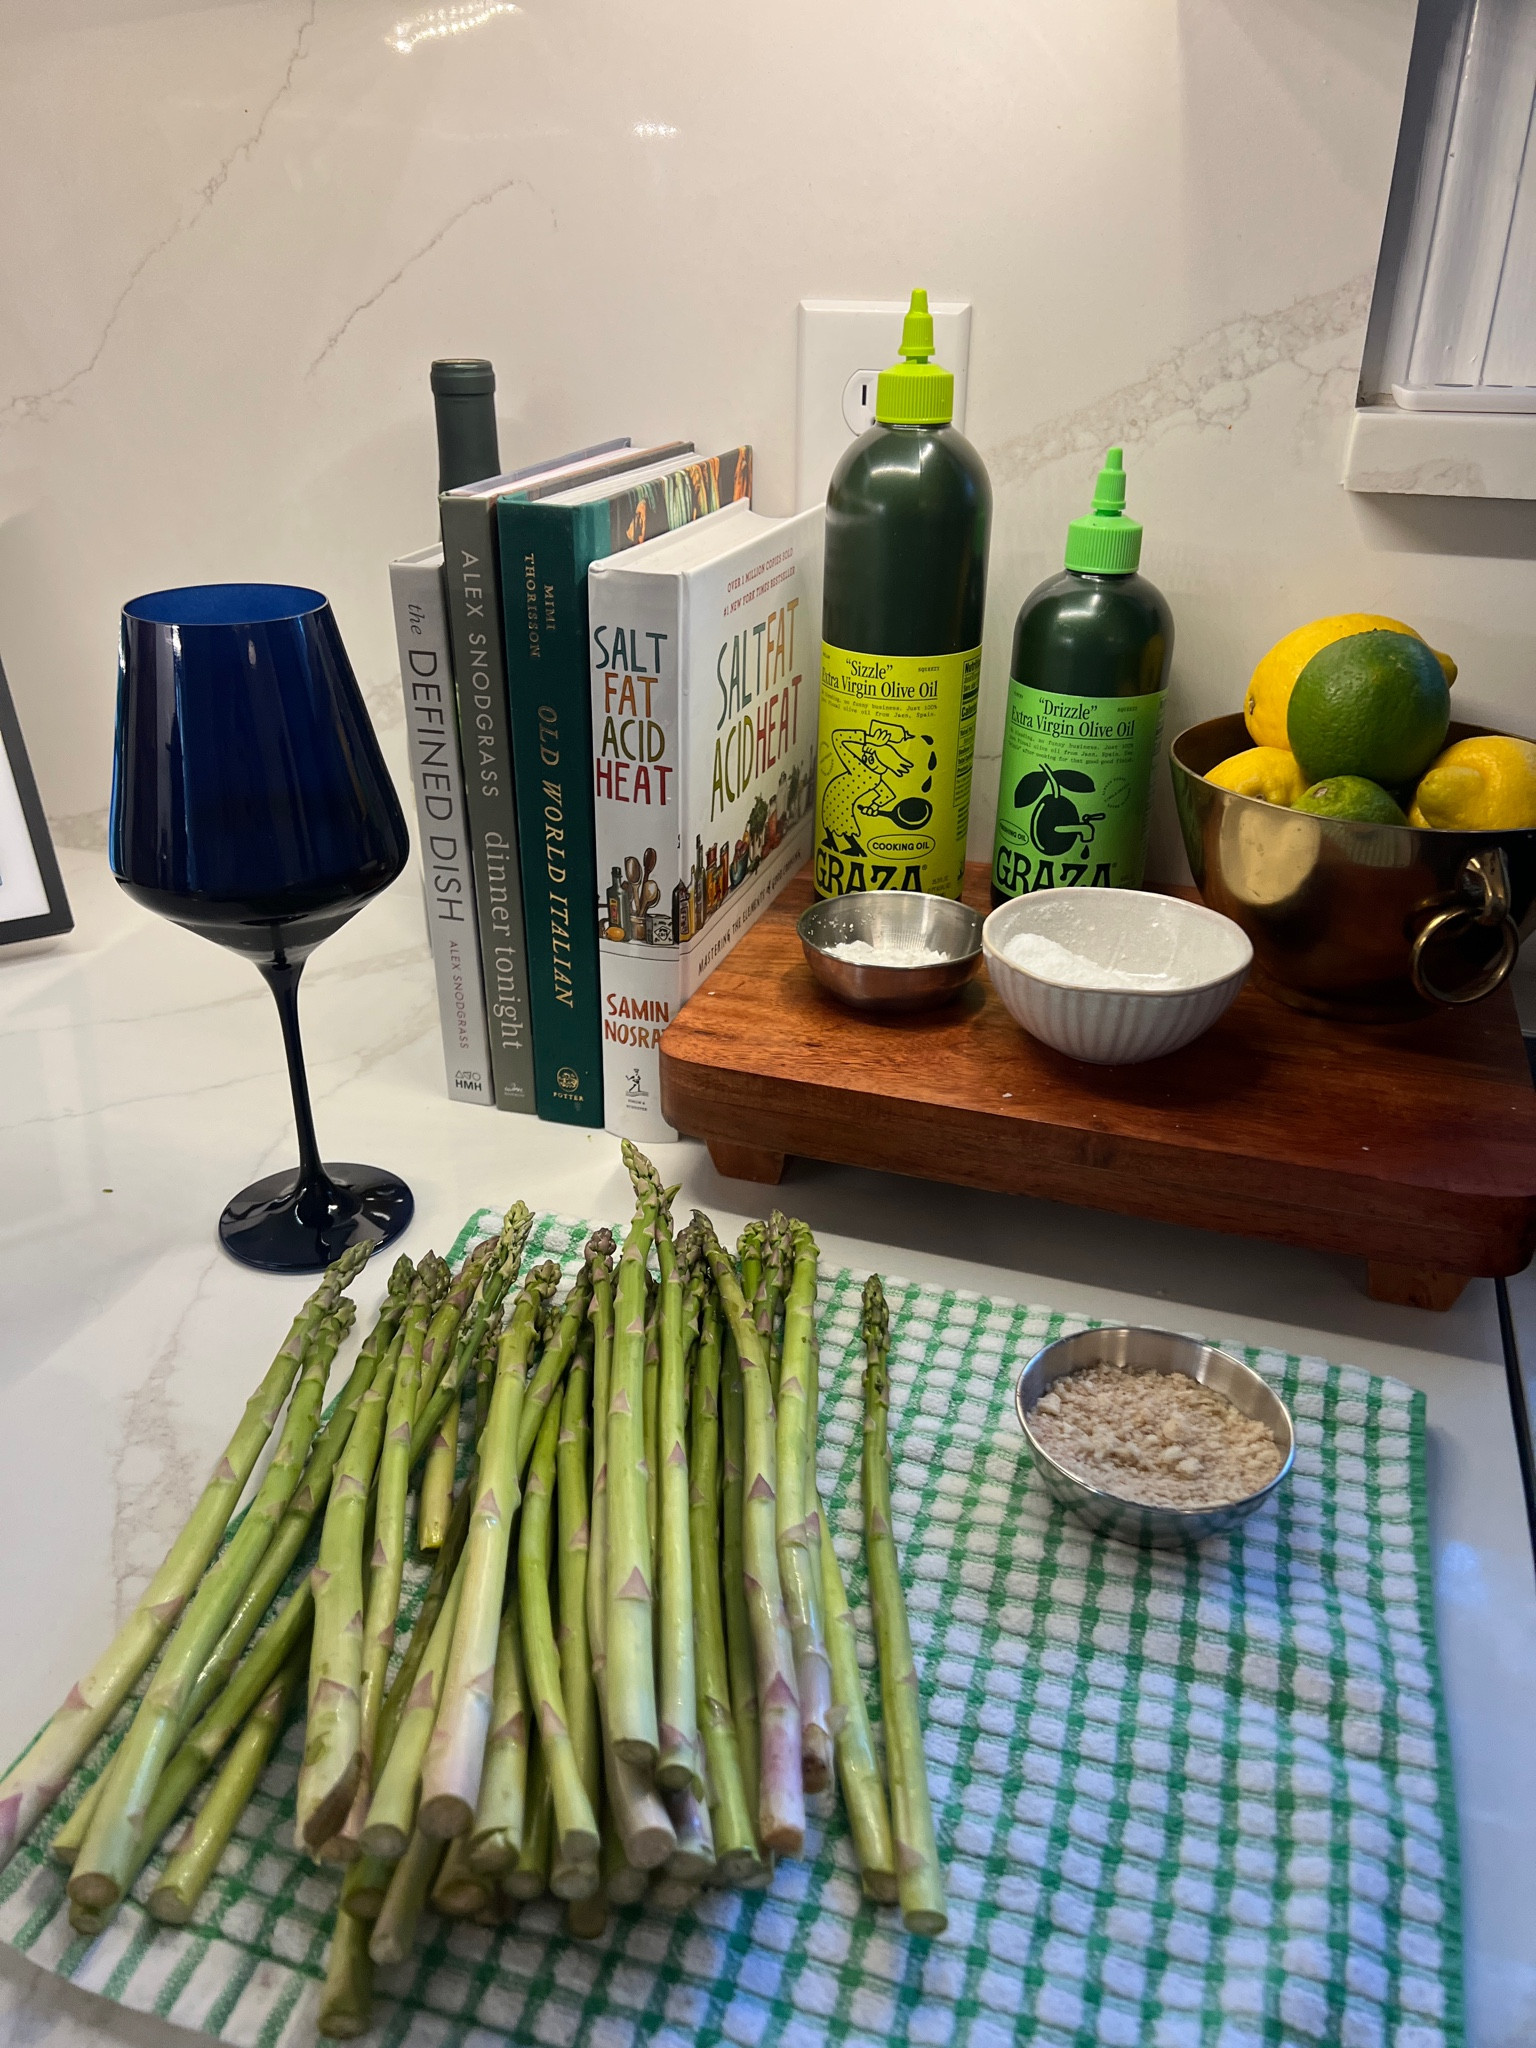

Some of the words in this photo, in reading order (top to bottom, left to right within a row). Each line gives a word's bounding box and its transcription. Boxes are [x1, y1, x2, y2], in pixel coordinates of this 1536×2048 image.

[461, 550, 484, 618] ALEX
[723, 605, 729, 616] #1
[730, 598, 742, 614] NEW
[743, 590, 756, 606] YORK
[756, 581, 770, 597] TIMES
[770, 566, 795, 588] BESTSELLER
[727, 577, 741, 593] OVER
[745, 563, 765, 583] MILLION
[766, 554, 781, 571] COPIES
[407, 604, 422, 635] the
[524, 553, 541, 658] THORISSON
[543, 584, 556, 631] MIMI
[593, 625, 668, 673] SALT
[717, 621, 766, 731] SALT
[765, 597, 799, 691] FAT
[604, 672, 658, 718] FAT
[842, 675, 877, 699] Virgin
[881, 681, 915, 698] Olive
[919, 680, 938, 698] Oil
[408, 650, 454, 822] DEFINED
[468, 633, 499, 798] SNODGRASS
[537, 705, 561, 766] OLD
[601, 715, 666, 763] ACID
[1011, 705, 1033, 728] Extra
[1037, 714, 1074, 738] Virgin
[1079, 721, 1114, 738] Olive
[1117, 720, 1135, 737] Oil
[710, 715, 754, 823] ACID
[755, 674, 802, 779] HEAT
[596, 757, 673, 806] HEAT
[541, 779, 567, 884] WORLD
[872, 842, 915, 851] COOKING
[915, 842, 930, 850] OIL
[1017, 833, 1027, 842] OIL
[429, 835, 465, 922] DISH
[484, 831, 513, 937] dinner
[450, 940, 462, 970] ALEX
[549, 893, 574, 1008] ITALIAN
[698, 928, 731, 976] MASTERING
[732, 917, 742, 935] THE
[453, 975, 469, 1049] SNODGRASS
[493, 946, 524, 1050] tonight
[606, 993, 670, 1023] SAMIN
[604, 1019, 664, 1050] NOSRA
[455, 1079, 482, 1092] HMH
[553, 1091, 584, 1102] POTTER
